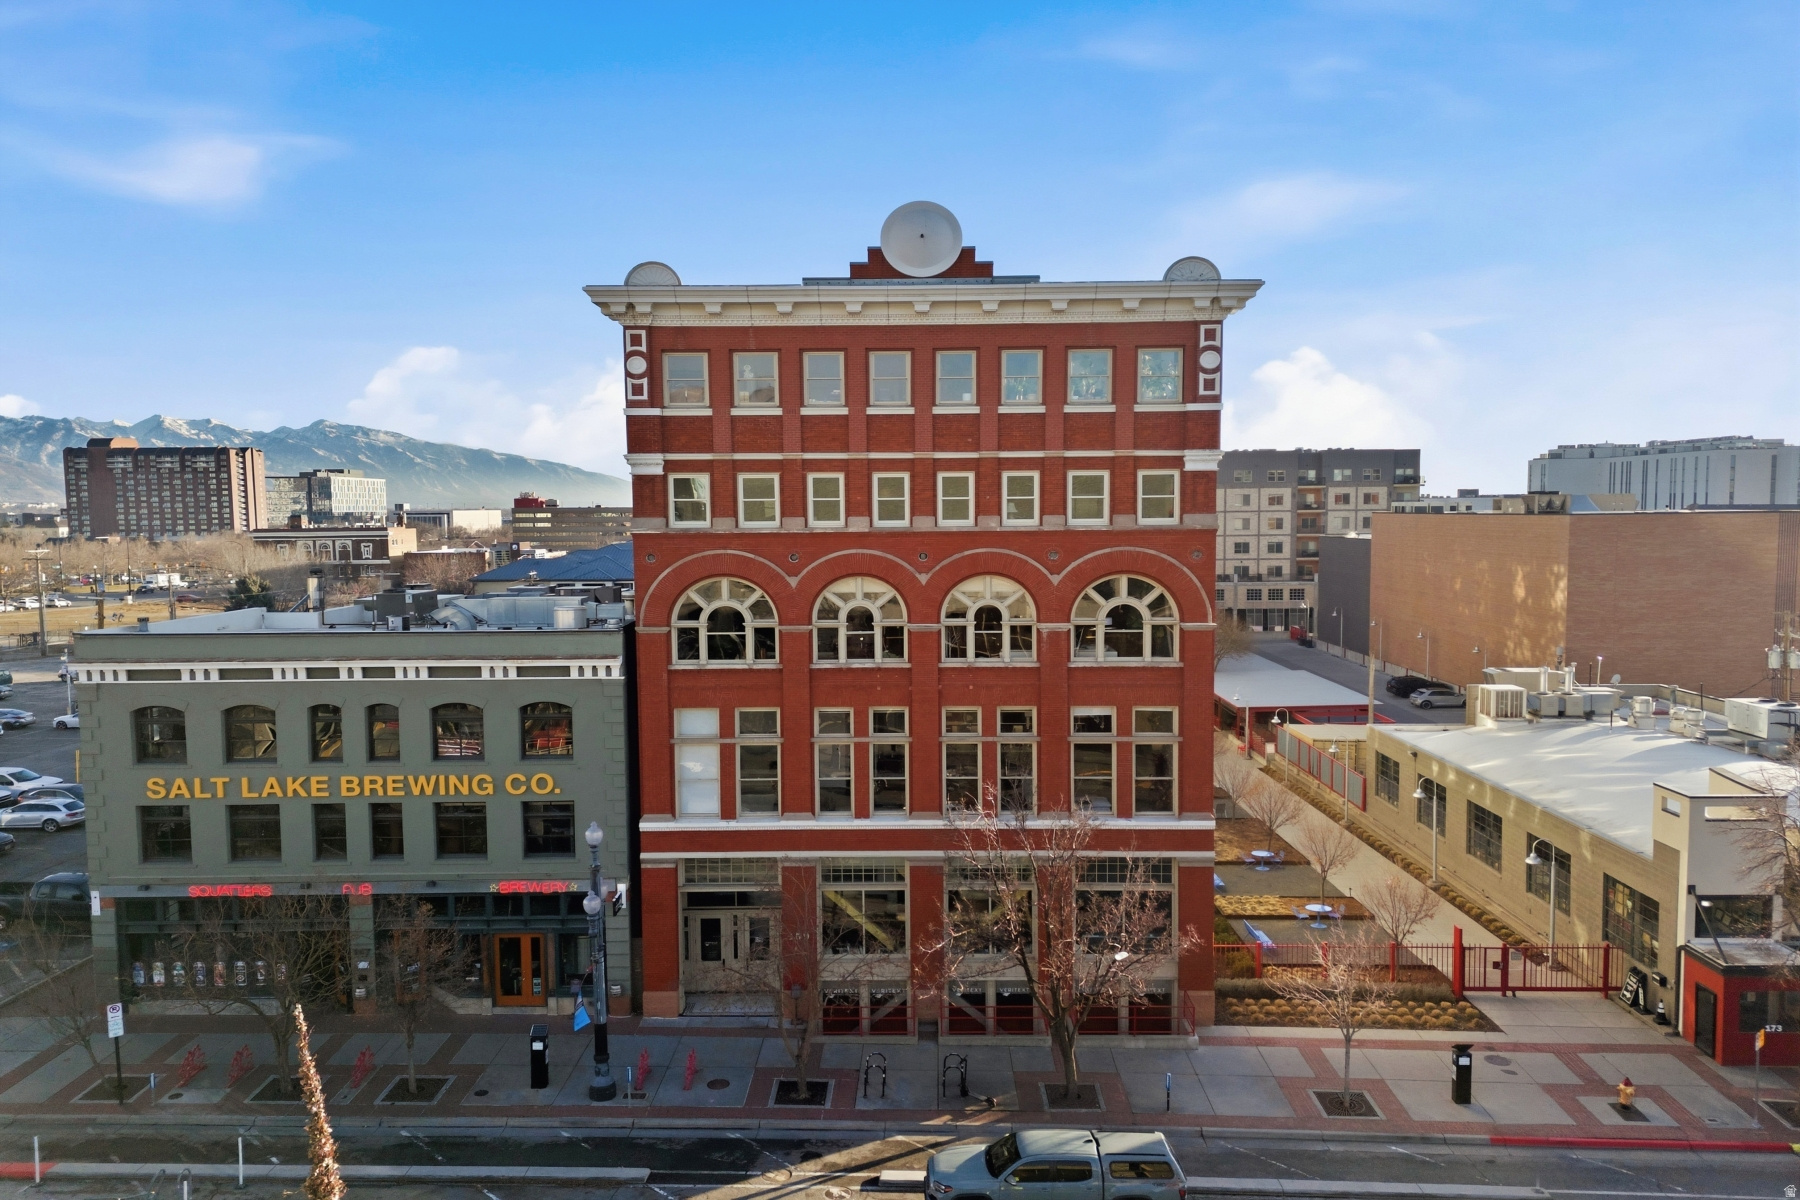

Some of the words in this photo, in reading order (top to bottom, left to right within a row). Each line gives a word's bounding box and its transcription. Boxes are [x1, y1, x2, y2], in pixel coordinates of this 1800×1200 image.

[146, 777, 230, 799] SALT
[241, 776, 330, 798] LAKE
[340, 774, 494, 797] BREWING
[505, 773, 561, 795] CO.
[188, 884, 273, 897] SQUATTERS
[342, 882, 372, 896] PUB
[499, 880, 569, 894] BREWERY
[1765, 1024, 1783, 1032] 173
